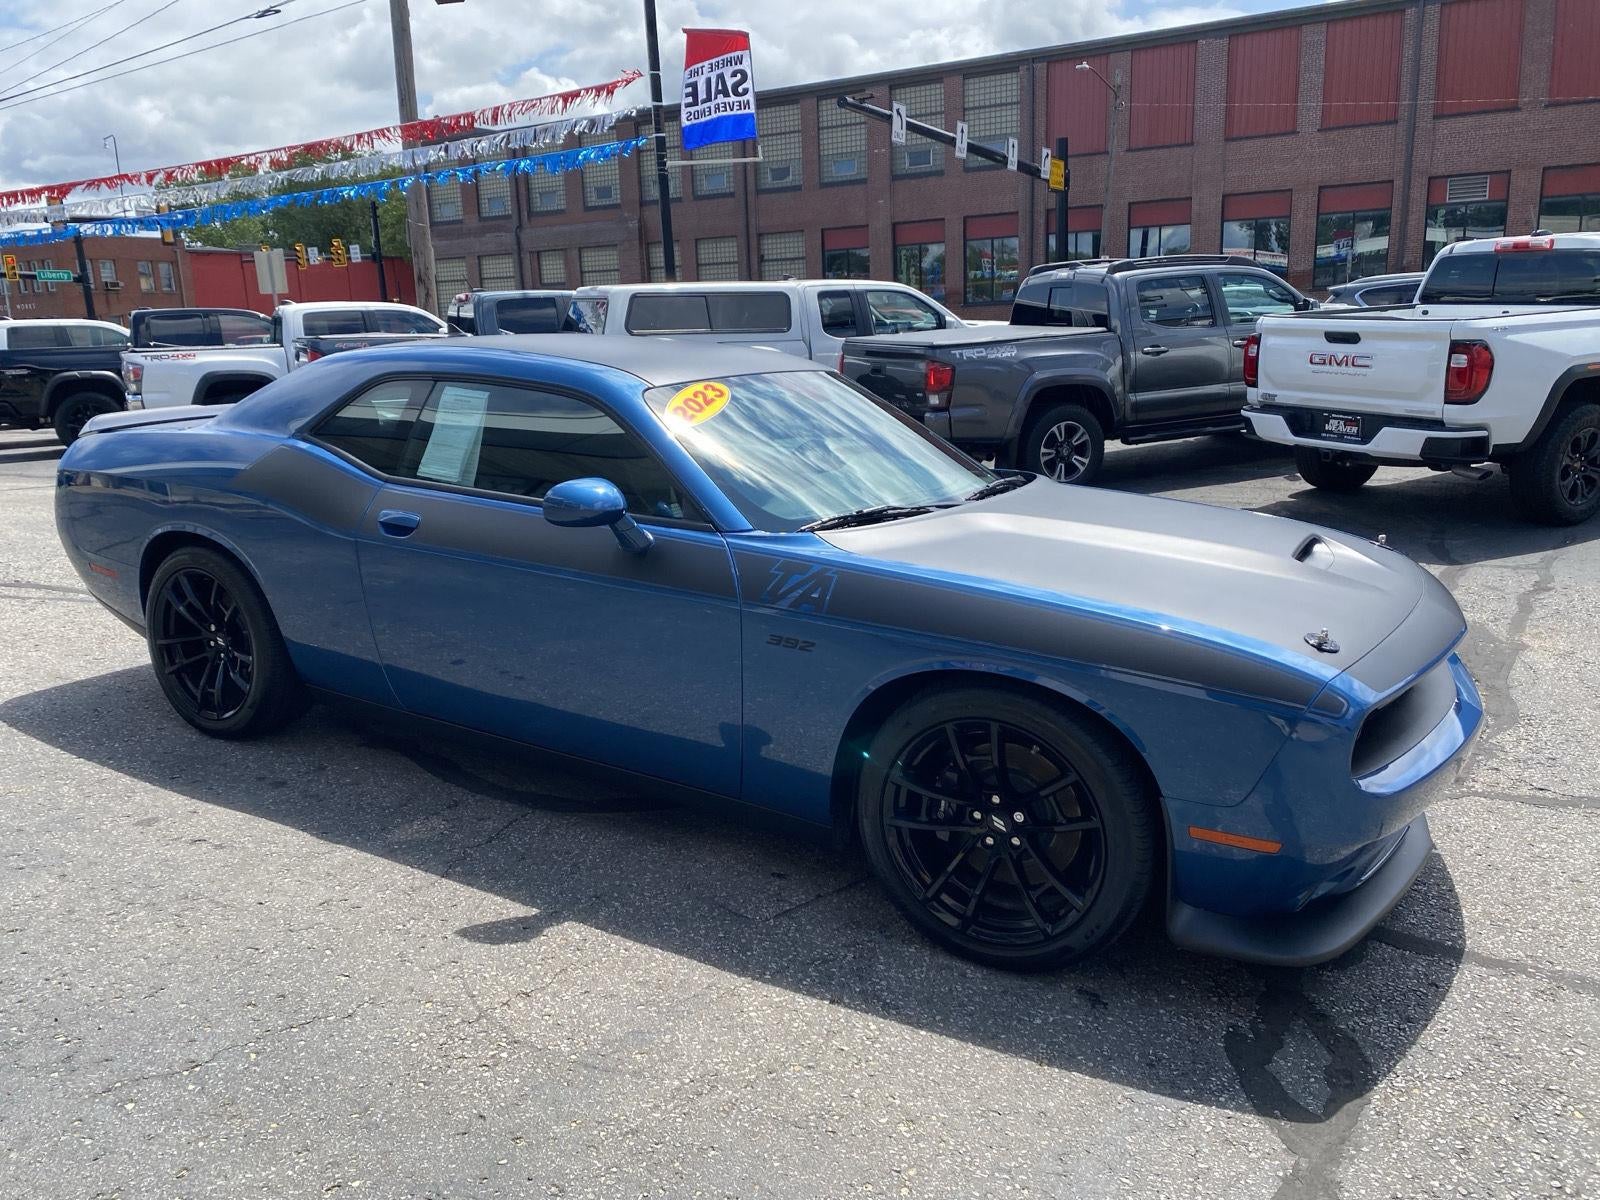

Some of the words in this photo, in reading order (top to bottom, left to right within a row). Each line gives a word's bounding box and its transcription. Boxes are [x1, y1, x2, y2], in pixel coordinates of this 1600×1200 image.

[40, 271, 68, 279] Liberty
[1309, 352, 1373, 368] GMC
[672, 384, 725, 422] 2023
[1325, 423, 1358, 433] WEAVER
[765, 634, 817, 653] 392
